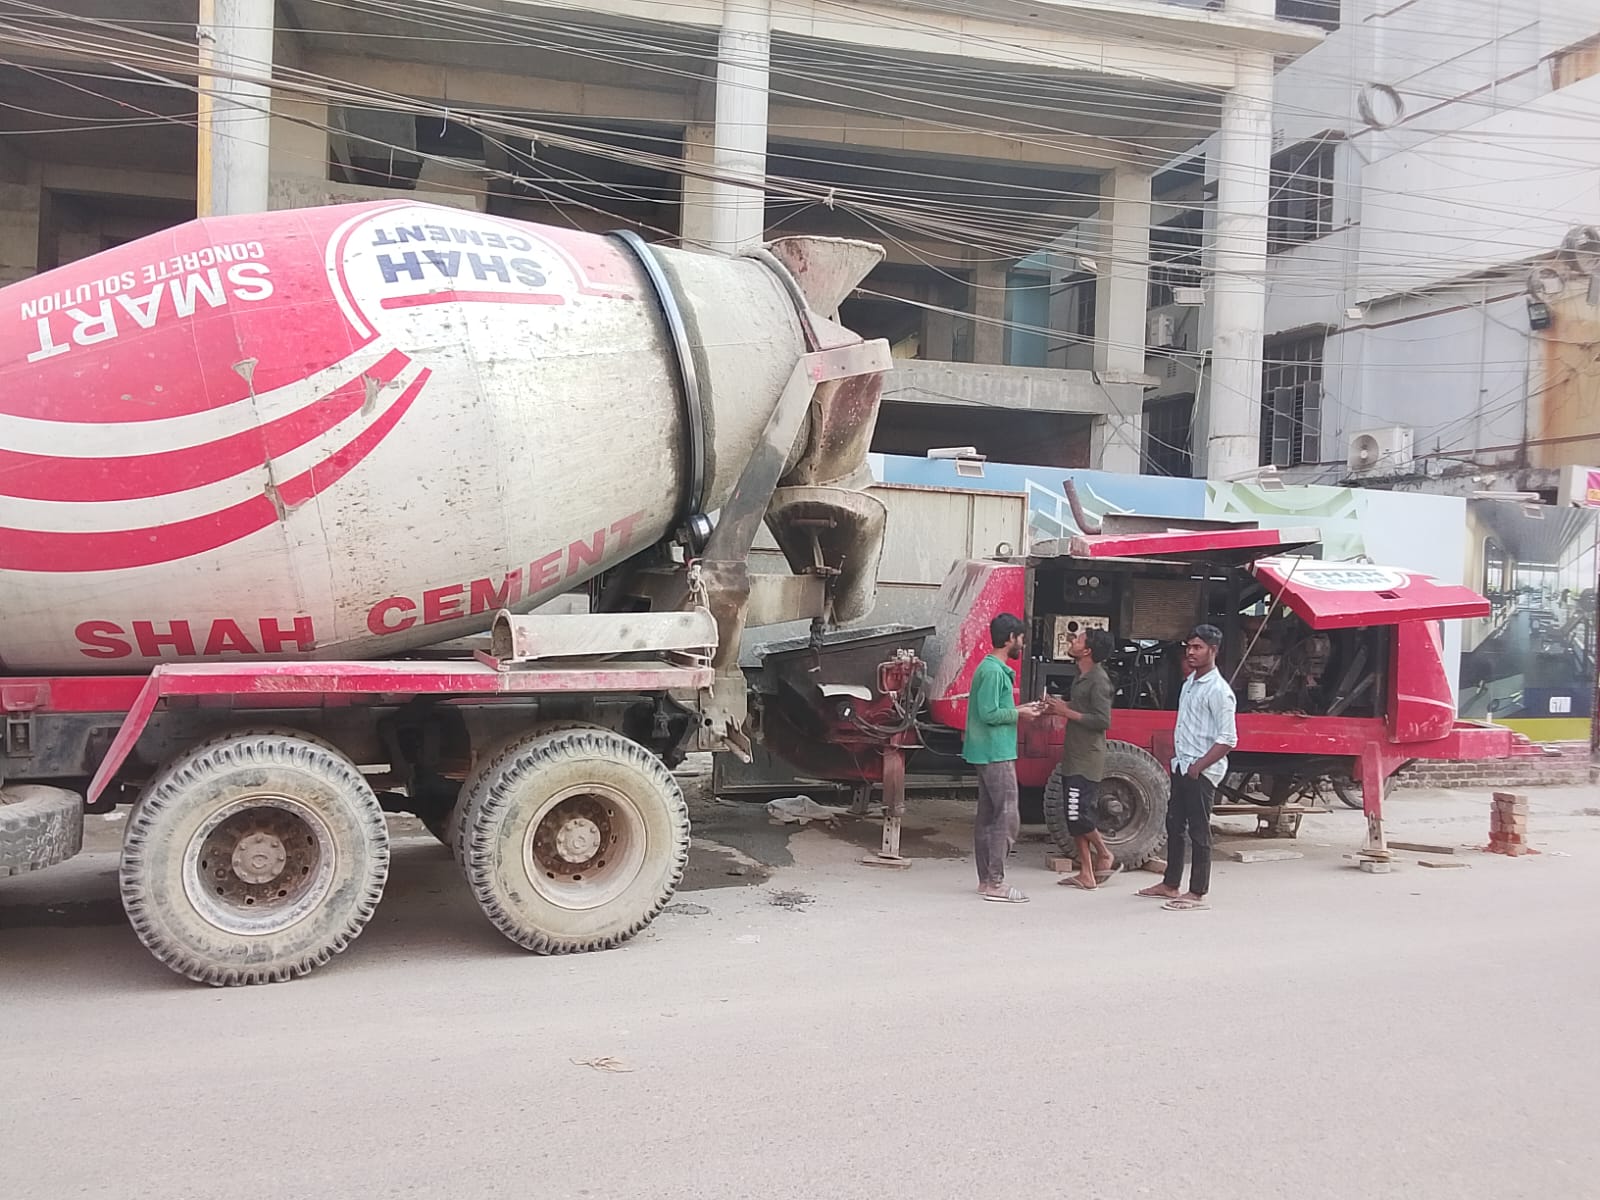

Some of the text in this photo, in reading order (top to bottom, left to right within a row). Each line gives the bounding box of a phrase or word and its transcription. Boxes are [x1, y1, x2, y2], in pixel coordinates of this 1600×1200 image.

[371, 224, 532, 252] CEMENT
[20, 241, 265, 321] CONCRETE SOLUTION
[376, 250, 547, 287] SHAH
[27, 262, 274, 363] SMART
[74, 511, 645, 659] SHAH CEMENT
[1303, 571, 1385, 579] SHAH
[1314, 578, 1393, 586] CEMENT
